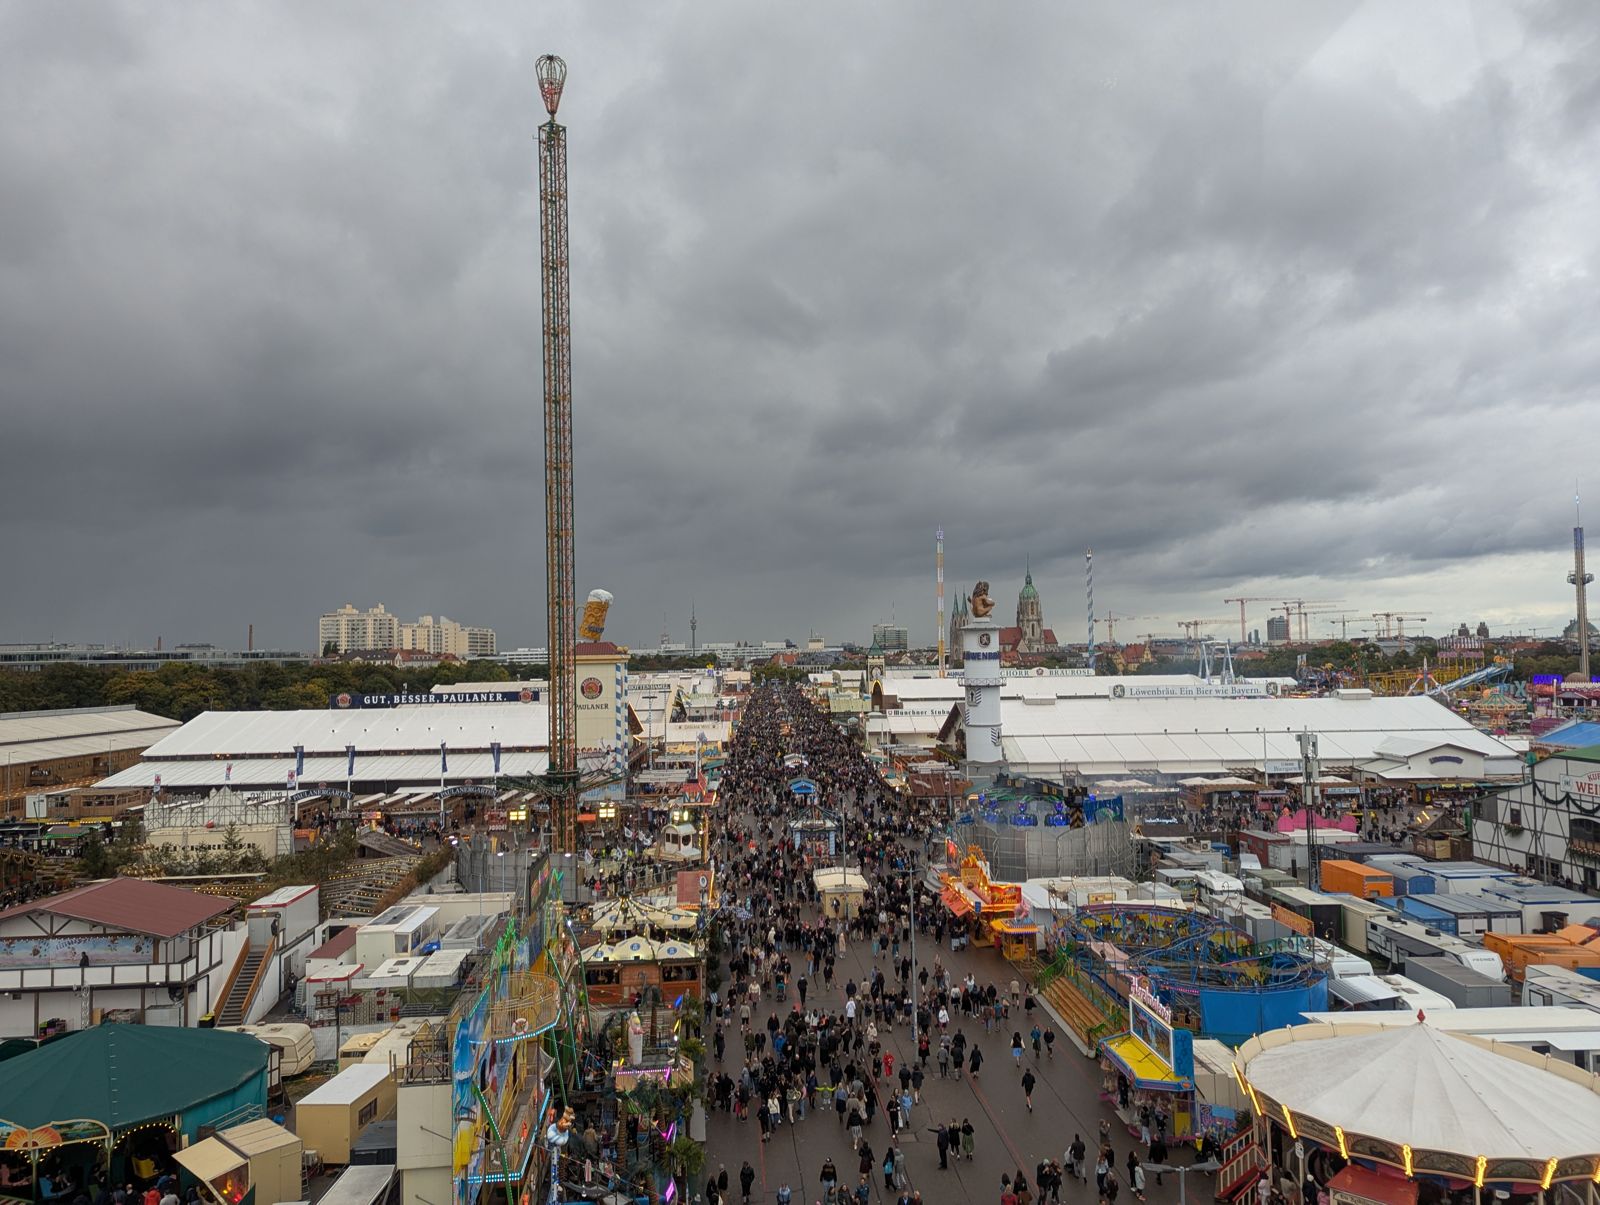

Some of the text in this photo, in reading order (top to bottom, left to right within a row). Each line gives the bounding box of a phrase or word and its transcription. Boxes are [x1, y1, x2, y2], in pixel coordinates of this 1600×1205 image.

[1180, 687, 1194, 696] Ein
[1196, 686, 1213, 695] Bier
[1215, 686, 1229, 695] wie
[363, 692, 507, 705] GUT, BESSER, PAULANER.
[1575, 781, 1600, 796] WEI
